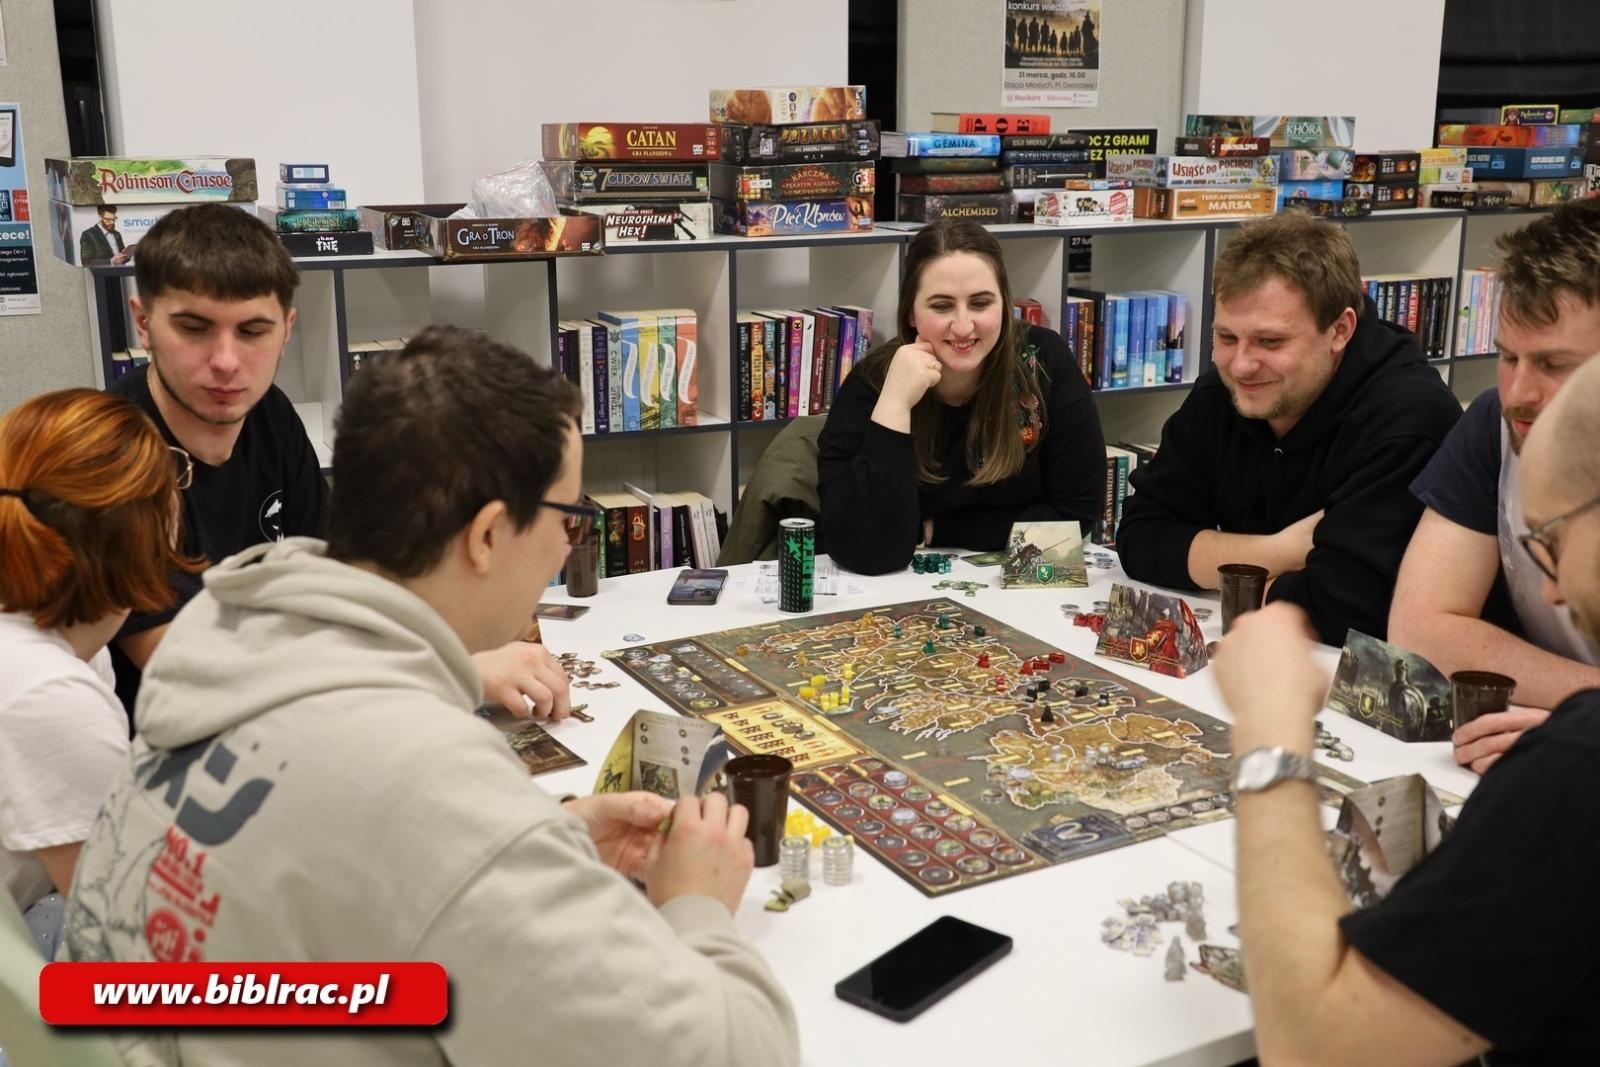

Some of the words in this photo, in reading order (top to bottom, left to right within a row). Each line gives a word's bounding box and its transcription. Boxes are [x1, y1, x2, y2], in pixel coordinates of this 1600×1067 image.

[1008, 2, 1040, 11] konkurs
[626, 129, 677, 147] CATAN
[933, 138, 976, 149] GEMINA
[1103, 135, 1111, 147] Z
[1112, 134, 1149, 147] GRAMI
[1089, 150, 1103, 160] EZ
[1206, 164, 1217, 174] DO
[98, 167, 173, 195] Robinson
[176, 169, 232, 194] Crusoe
[598, 168, 613, 191] 7
[791, 170, 829, 182] KARCZMA
[1208, 200, 1252, 211] MARSA
[941, 207, 999, 217] ALCHEMISED
[606, 214, 673, 226] NEUROSHIMA
[0, 230, 30, 240] ece!
[618, 225, 647, 238] HEX!
[1071, 237, 1081, 246] 27
[801, 535, 815, 601] BLACK
